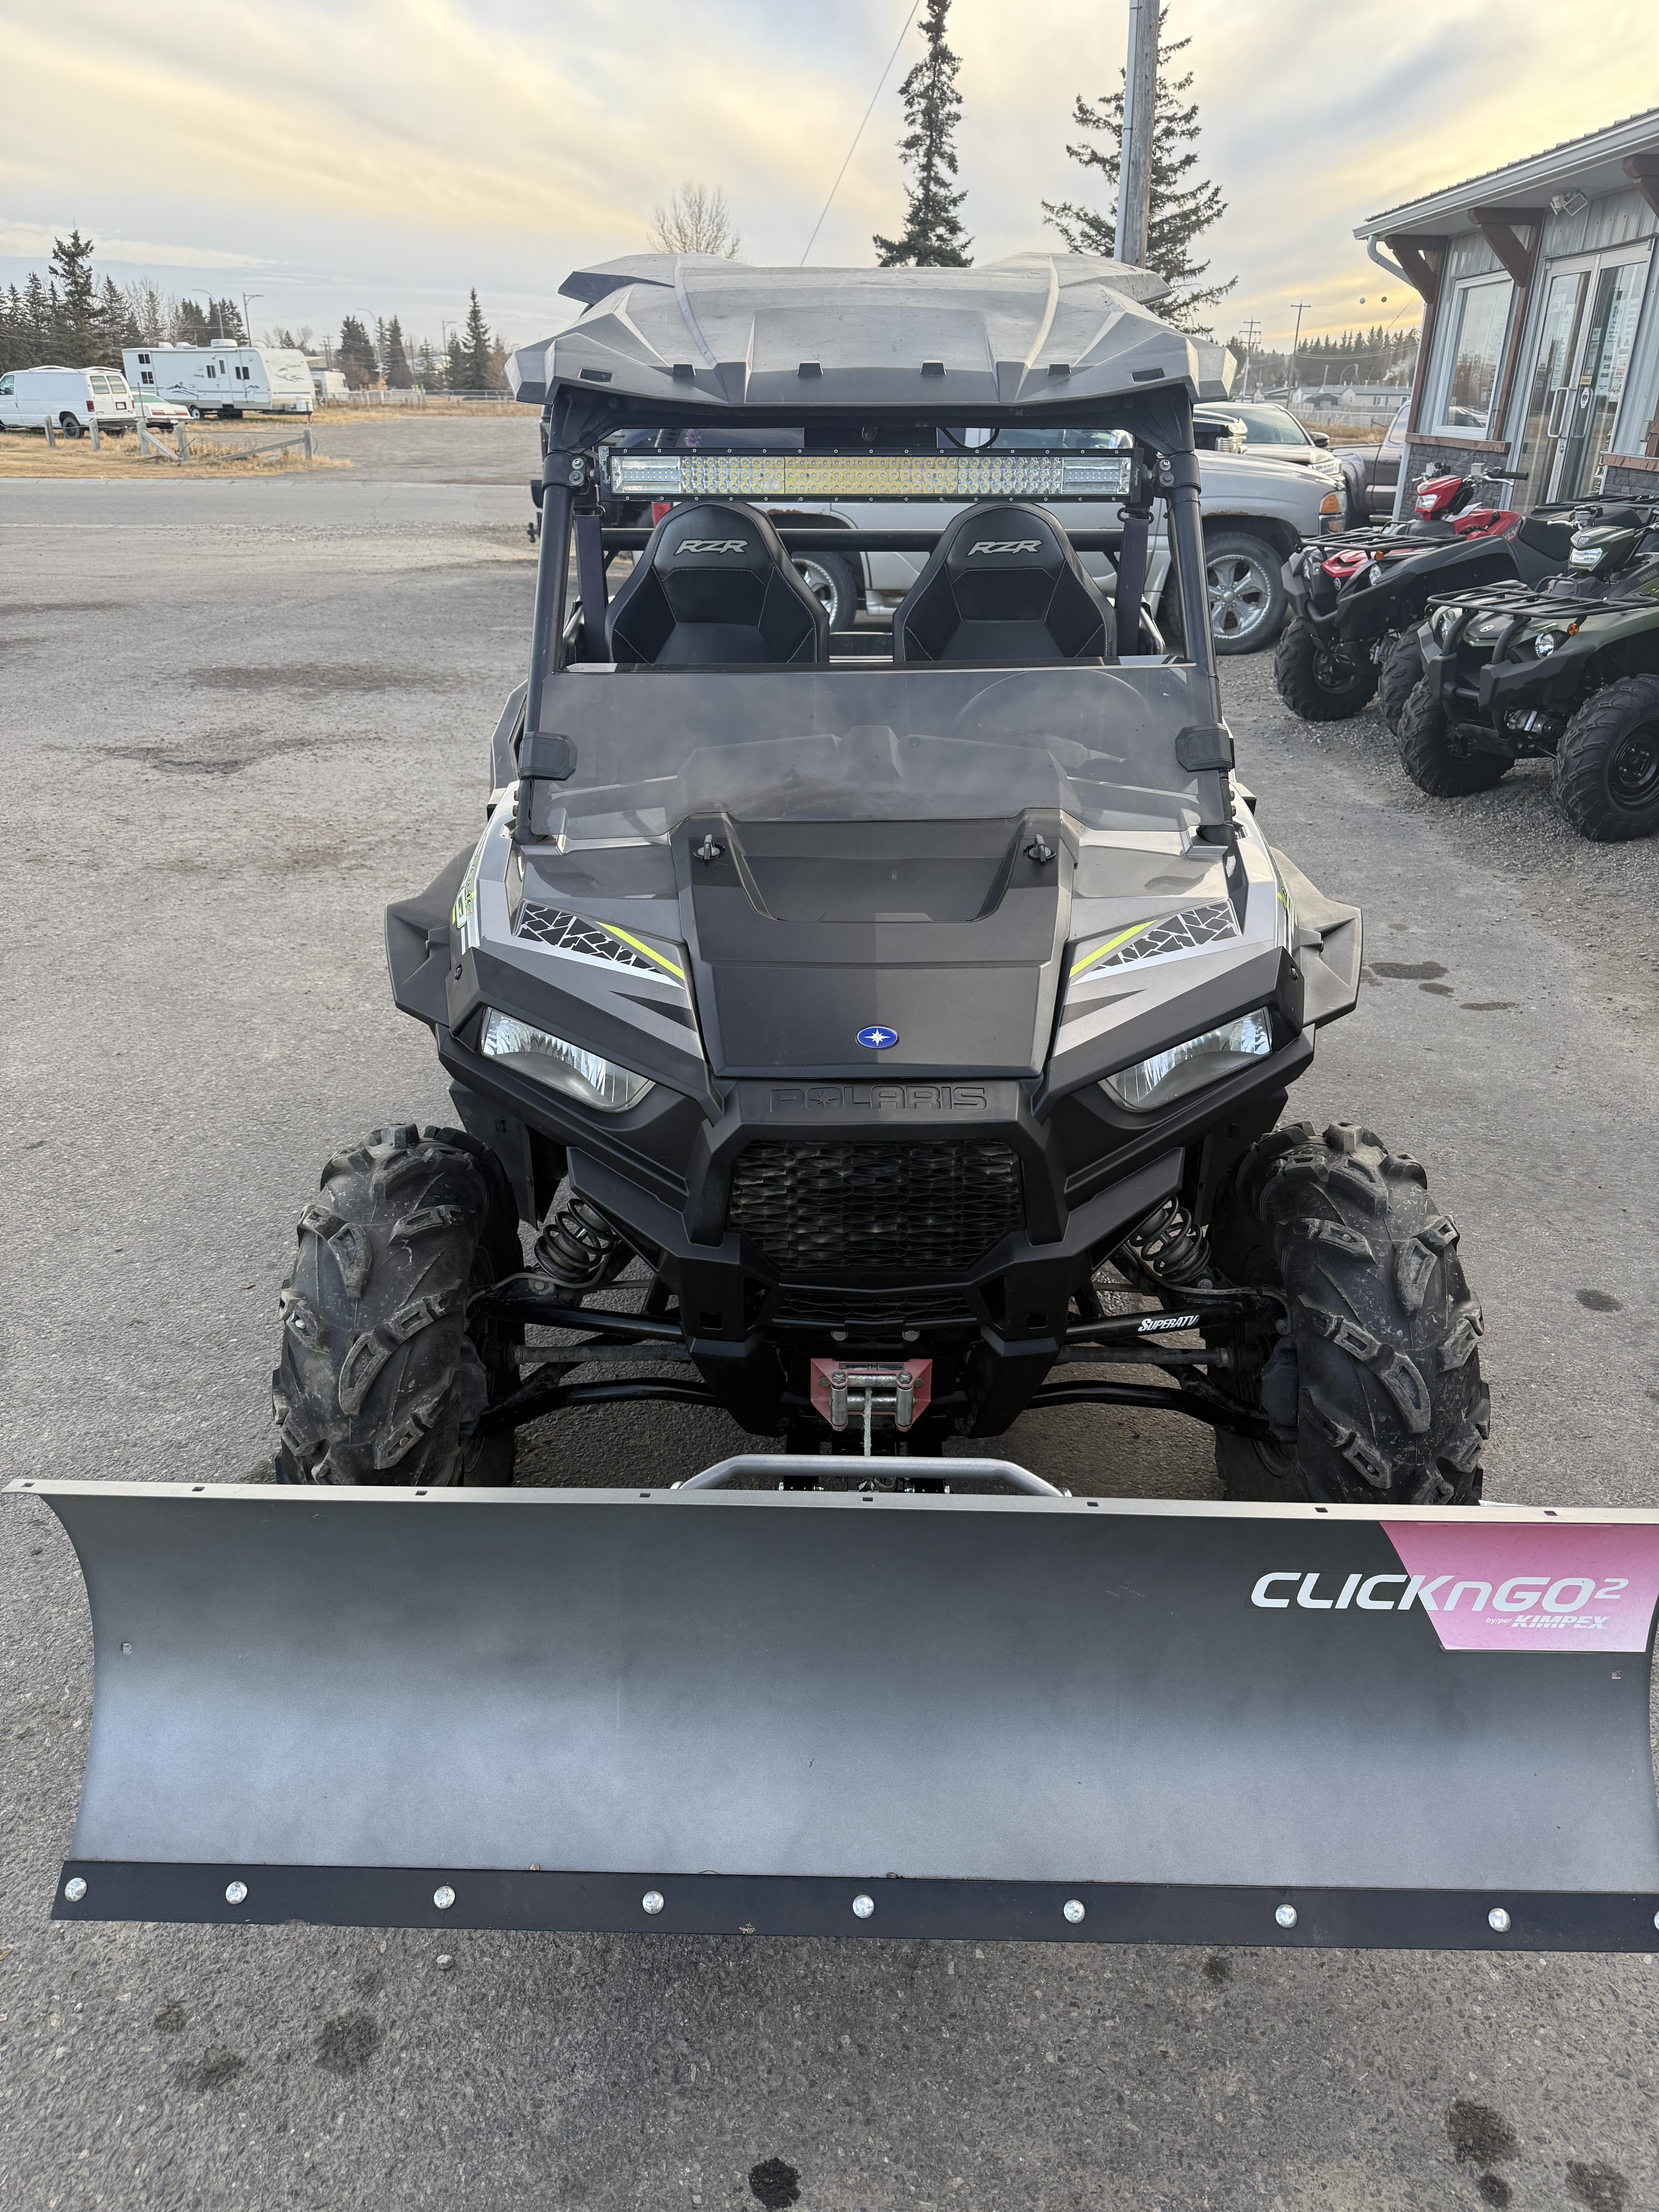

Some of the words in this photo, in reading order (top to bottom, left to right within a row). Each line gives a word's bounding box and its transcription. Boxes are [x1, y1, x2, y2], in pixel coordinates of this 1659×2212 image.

[674, 539, 749, 555] RZR
[966, 540, 1042, 556] RZR
[1637, 569, 1658, 583] YAMAHA
[770, 1085, 987, 1112] POLARIS
[1511, 1614, 1610, 1629] KIMPEX
